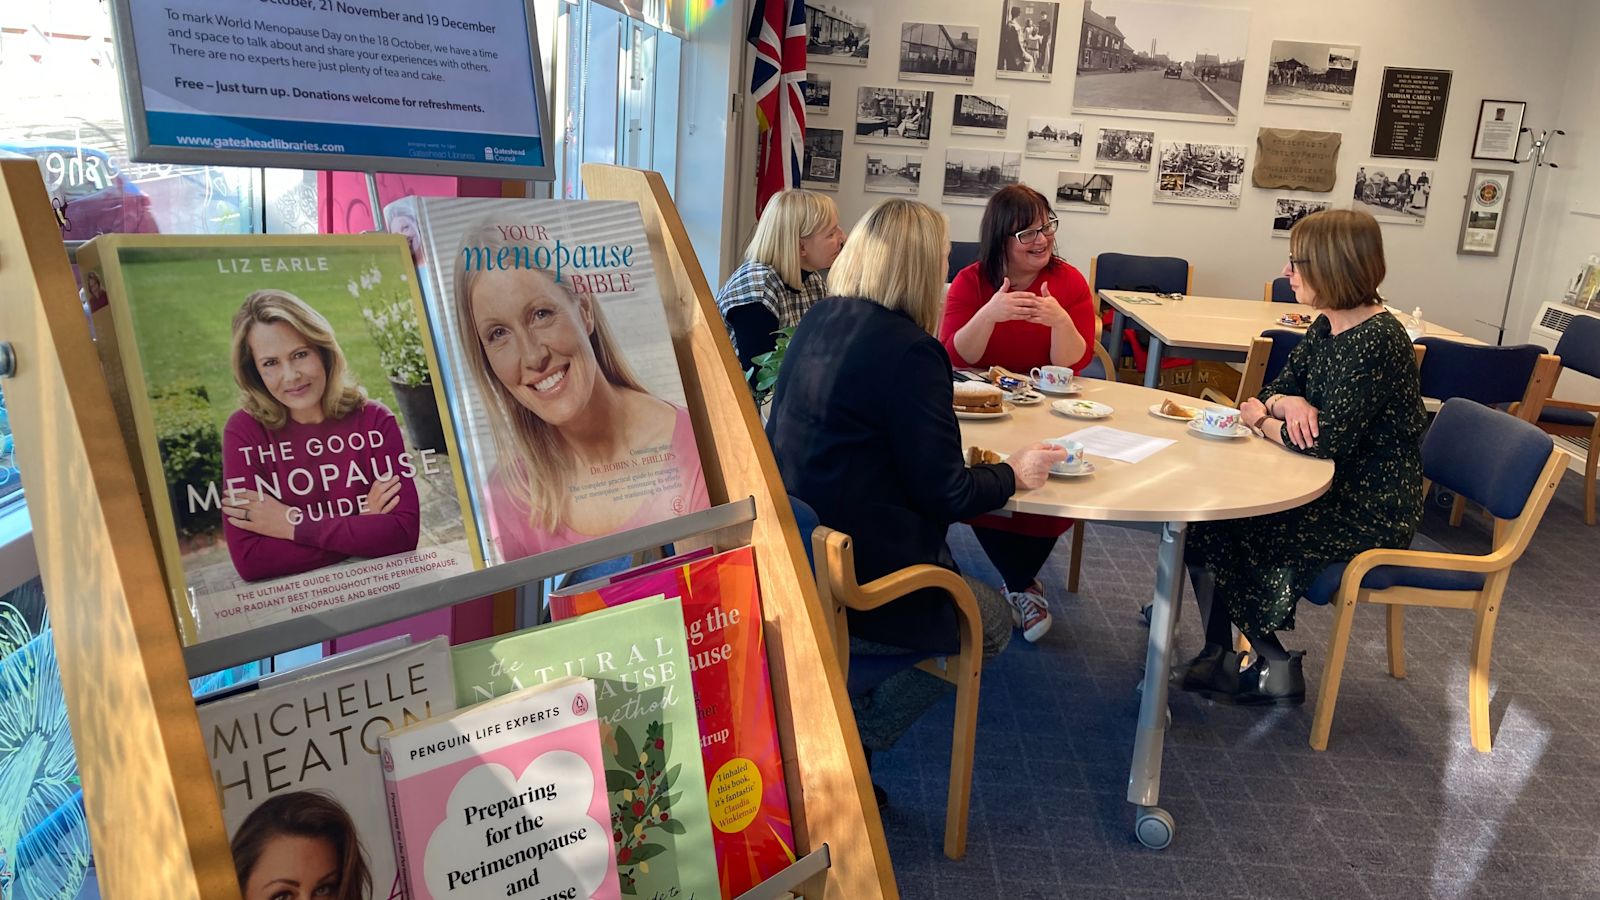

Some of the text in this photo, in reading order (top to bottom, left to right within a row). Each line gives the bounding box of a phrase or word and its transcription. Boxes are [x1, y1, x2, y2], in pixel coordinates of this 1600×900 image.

[165, 8, 179, 20] To
[182, 12, 213, 24] mark
[215, 14, 250, 30] World
[254, 20, 319, 38] Menopause
[322, 29, 342, 42] Day
[345, 34, 357, 42] on
[359, 32, 376, 45] the
[378, 35, 389, 46] 18
[391, 37, 433, 53] October,
[434, 45, 448, 53] we
[450, 45, 471, 56] have
[479, 48, 499, 59] time
[258, 0, 496, 34] ober, 21 November and 19 December
[168, 28, 491, 72] and space to talk about and share your experiences with others.
[169, 43, 446, 83] There are no experts here just plenty of tea and cake.
[175, 77, 204, 89] Free
[216, 80, 239, 93] Just
[241, 84, 268, 95] turn
[270, 88, 290, 98] up.
[293, 87, 350, 102] Donations
[352, 94, 400, 106] welcome
[402, 97, 416, 107] for
[418, 99, 485, 113] refreshments.
[176, 134, 345, 153] www.gatesheadlibraries.com
[494, 147, 526, 156] Gateshead
[494, 154, 516, 162] Council
[497, 224, 549, 241] YOUR
[216, 257, 329, 274] LIZ EARLE
[462, 239, 635, 283] menopause
[571, 273, 635, 294] BIBLE
[238, 430, 384, 466] THE GOOD
[642, 451, 677, 466] PHILLIPS
[186, 448, 440, 515] MENOPAUSE
[285, 494, 372, 526] GUIDE
[236, 551, 438, 602] THE ULTIMATE GUIDE TO LOOKING AND FEELING
[214, 606, 243, 620] YOUR
[244, 598, 286, 613] RADIANT
[287, 592, 309, 603] BEST
[311, 577, 371, 598] THROUGHOUT
[373, 573, 390, 584] THE
[290, 581, 401, 615] MENOPAUSE AND BEYOND
[706, 607, 741, 633] the
[472, 636, 674, 703] NATURAL
[488, 656, 525, 678] the
[213, 662, 428, 760] MICHELLE
[410, 706, 561, 760] PENGUIN LIFE EXPERTS
[214, 700, 432, 810] HEATON
[723, 762, 748, 780] inhaled
[463, 782, 558, 826] Preparing
[717, 783, 732, 794] this
[718, 805, 757, 828] Winkleman
[724, 798, 750, 815] Claudia
[485, 813, 544, 847] for the
[447, 826, 588, 891] Perimenopause
[506, 868, 541, 897] and
